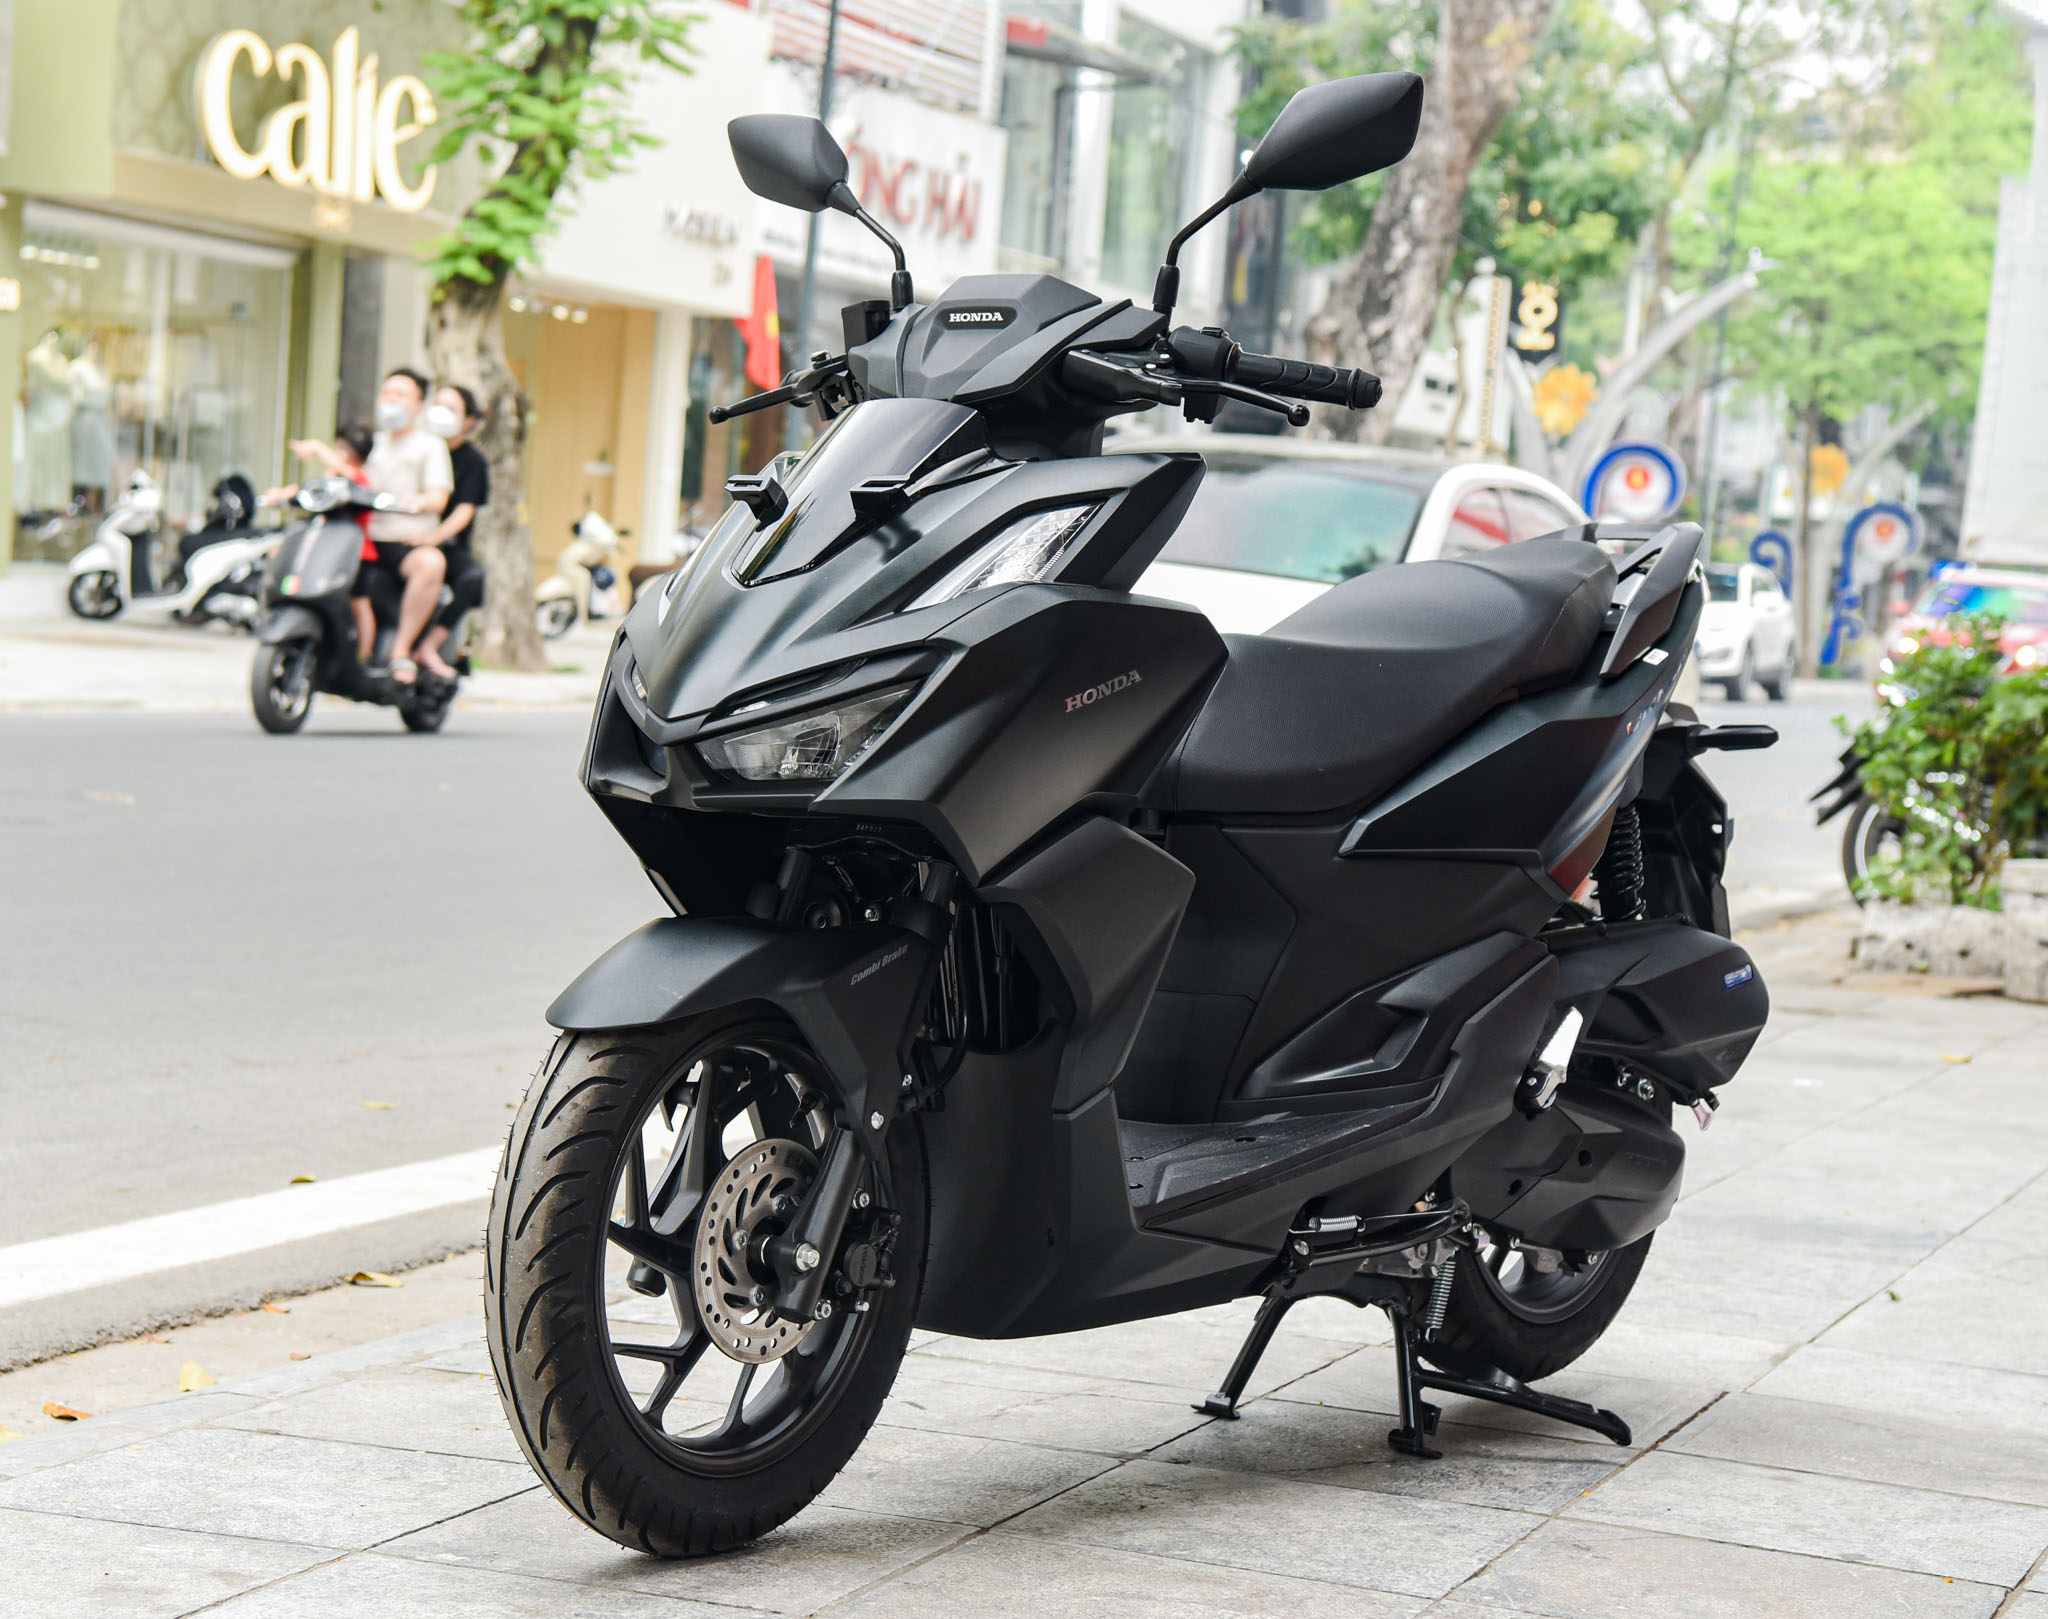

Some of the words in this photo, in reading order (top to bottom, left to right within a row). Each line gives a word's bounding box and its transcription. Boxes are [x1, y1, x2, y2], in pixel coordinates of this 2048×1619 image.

[949, 312, 1004, 323] HONDA
[1065, 669, 1143, 713] HONDA
[850, 959, 881, 986] Combi
[881, 944, 909, 968] Brake
